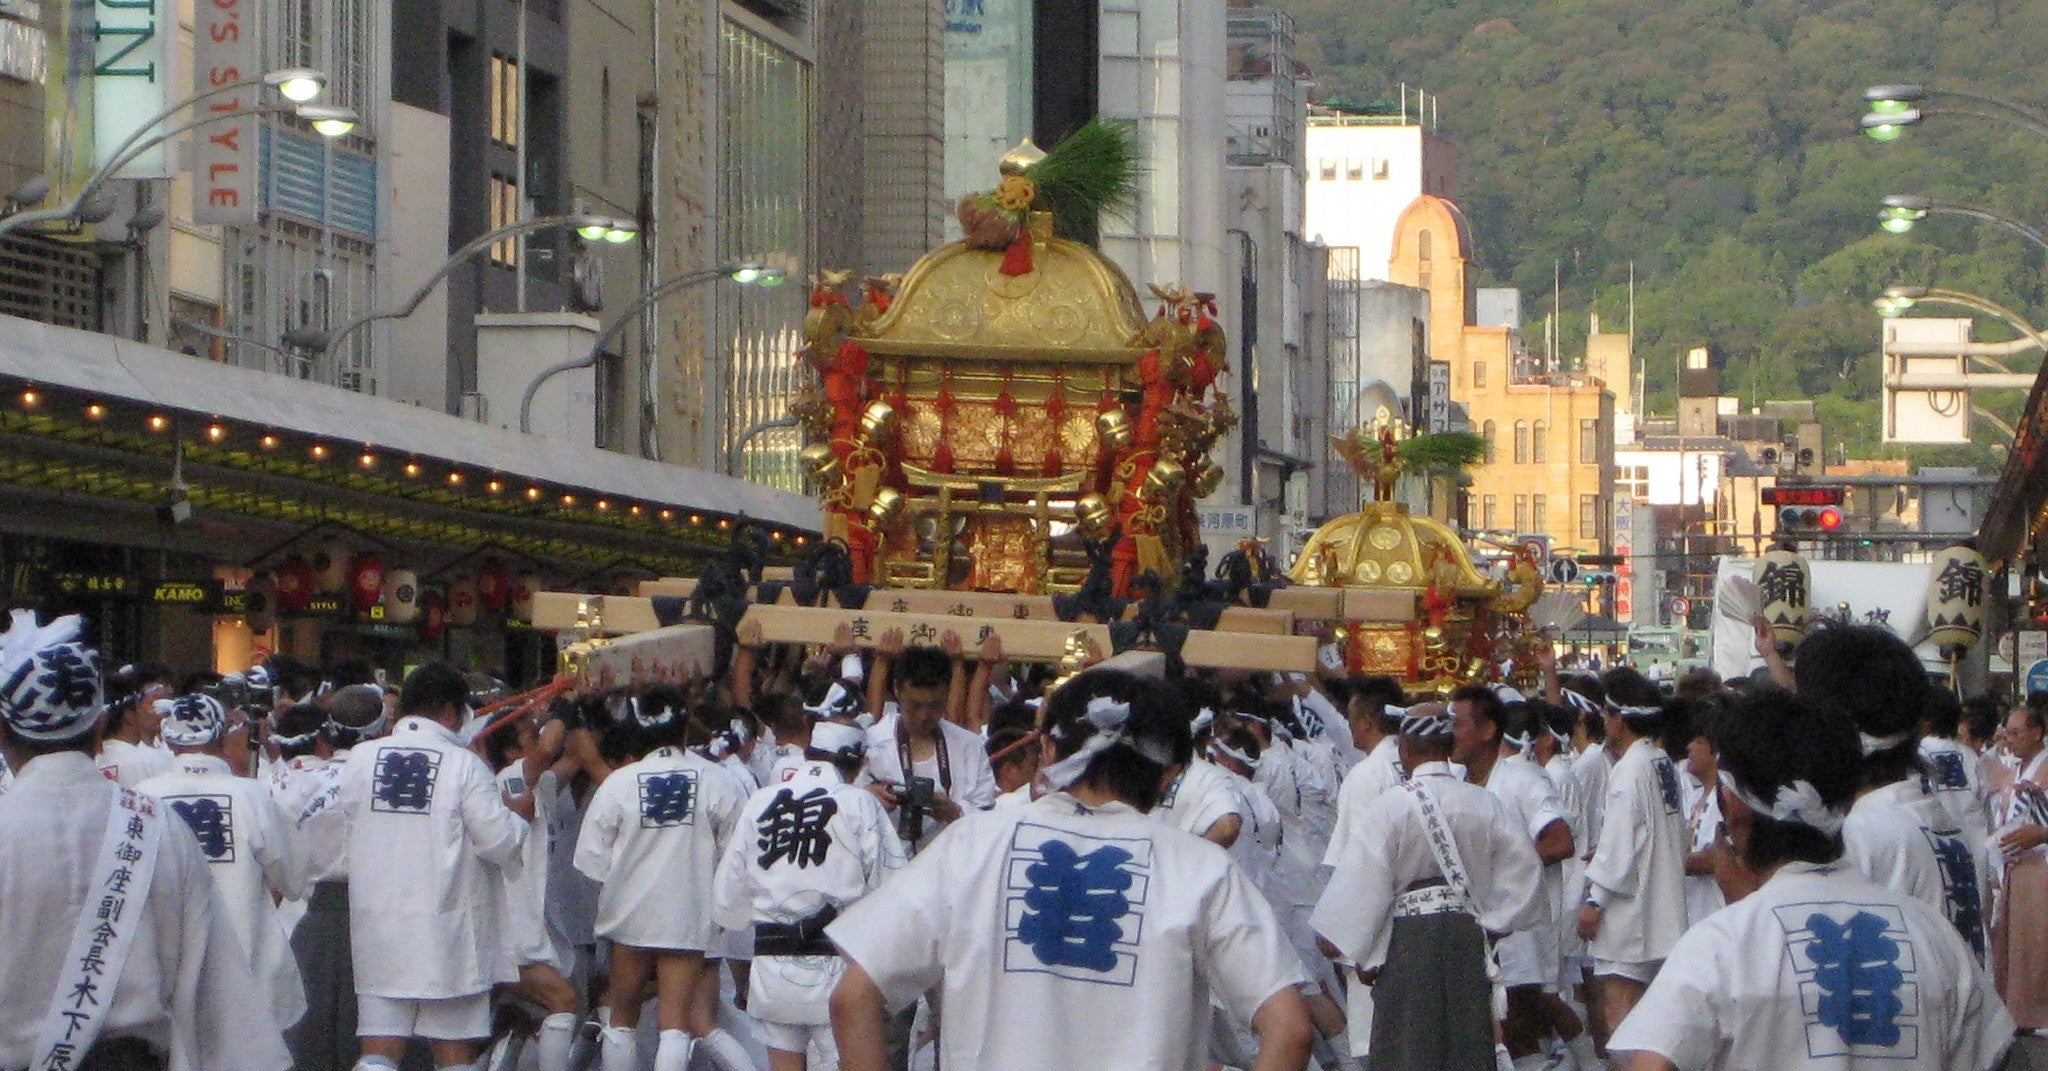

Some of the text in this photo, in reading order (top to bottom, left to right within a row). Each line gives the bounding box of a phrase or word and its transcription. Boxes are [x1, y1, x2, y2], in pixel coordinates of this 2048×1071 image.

[95, 0, 154, 84] N
[1758, 560, 1806, 608] 錦
[1936, 557, 1985, 607] 錦
[755, 786, 839, 871] 錦
